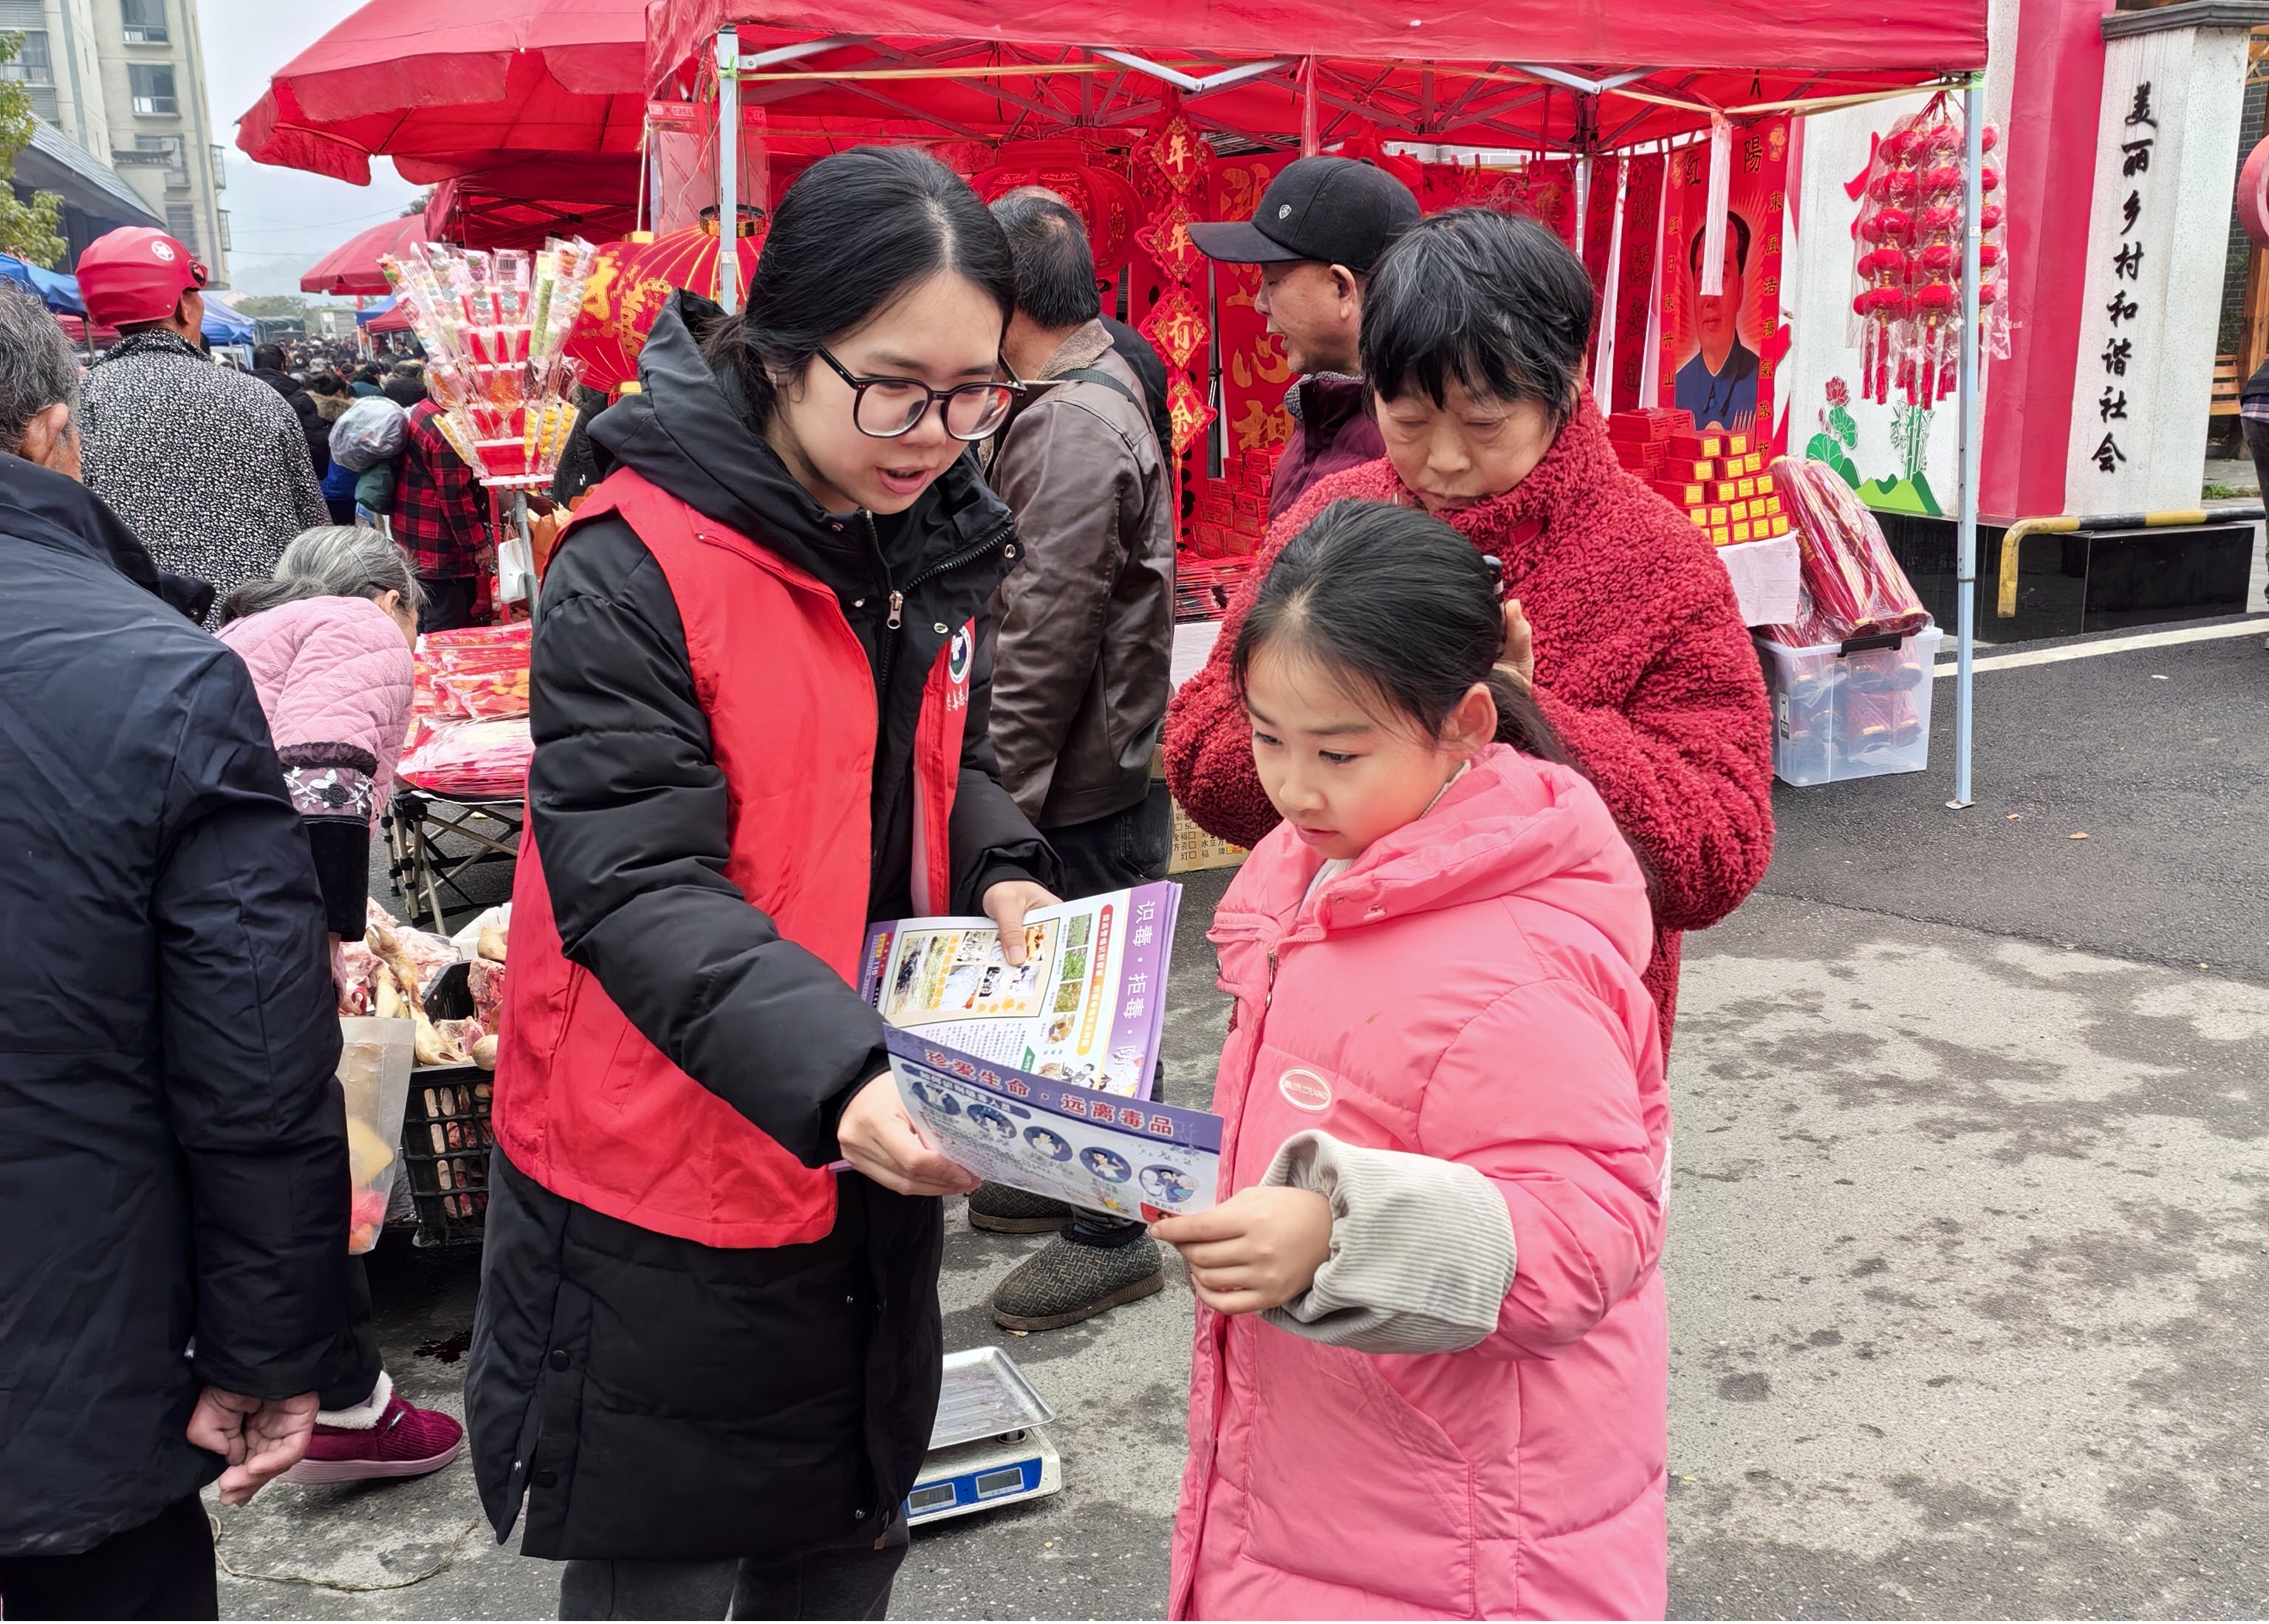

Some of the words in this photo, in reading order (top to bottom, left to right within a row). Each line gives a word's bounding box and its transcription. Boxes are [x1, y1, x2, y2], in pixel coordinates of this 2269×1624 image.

[2092, 80, 2157, 473] 美丽乡村和谐社会
